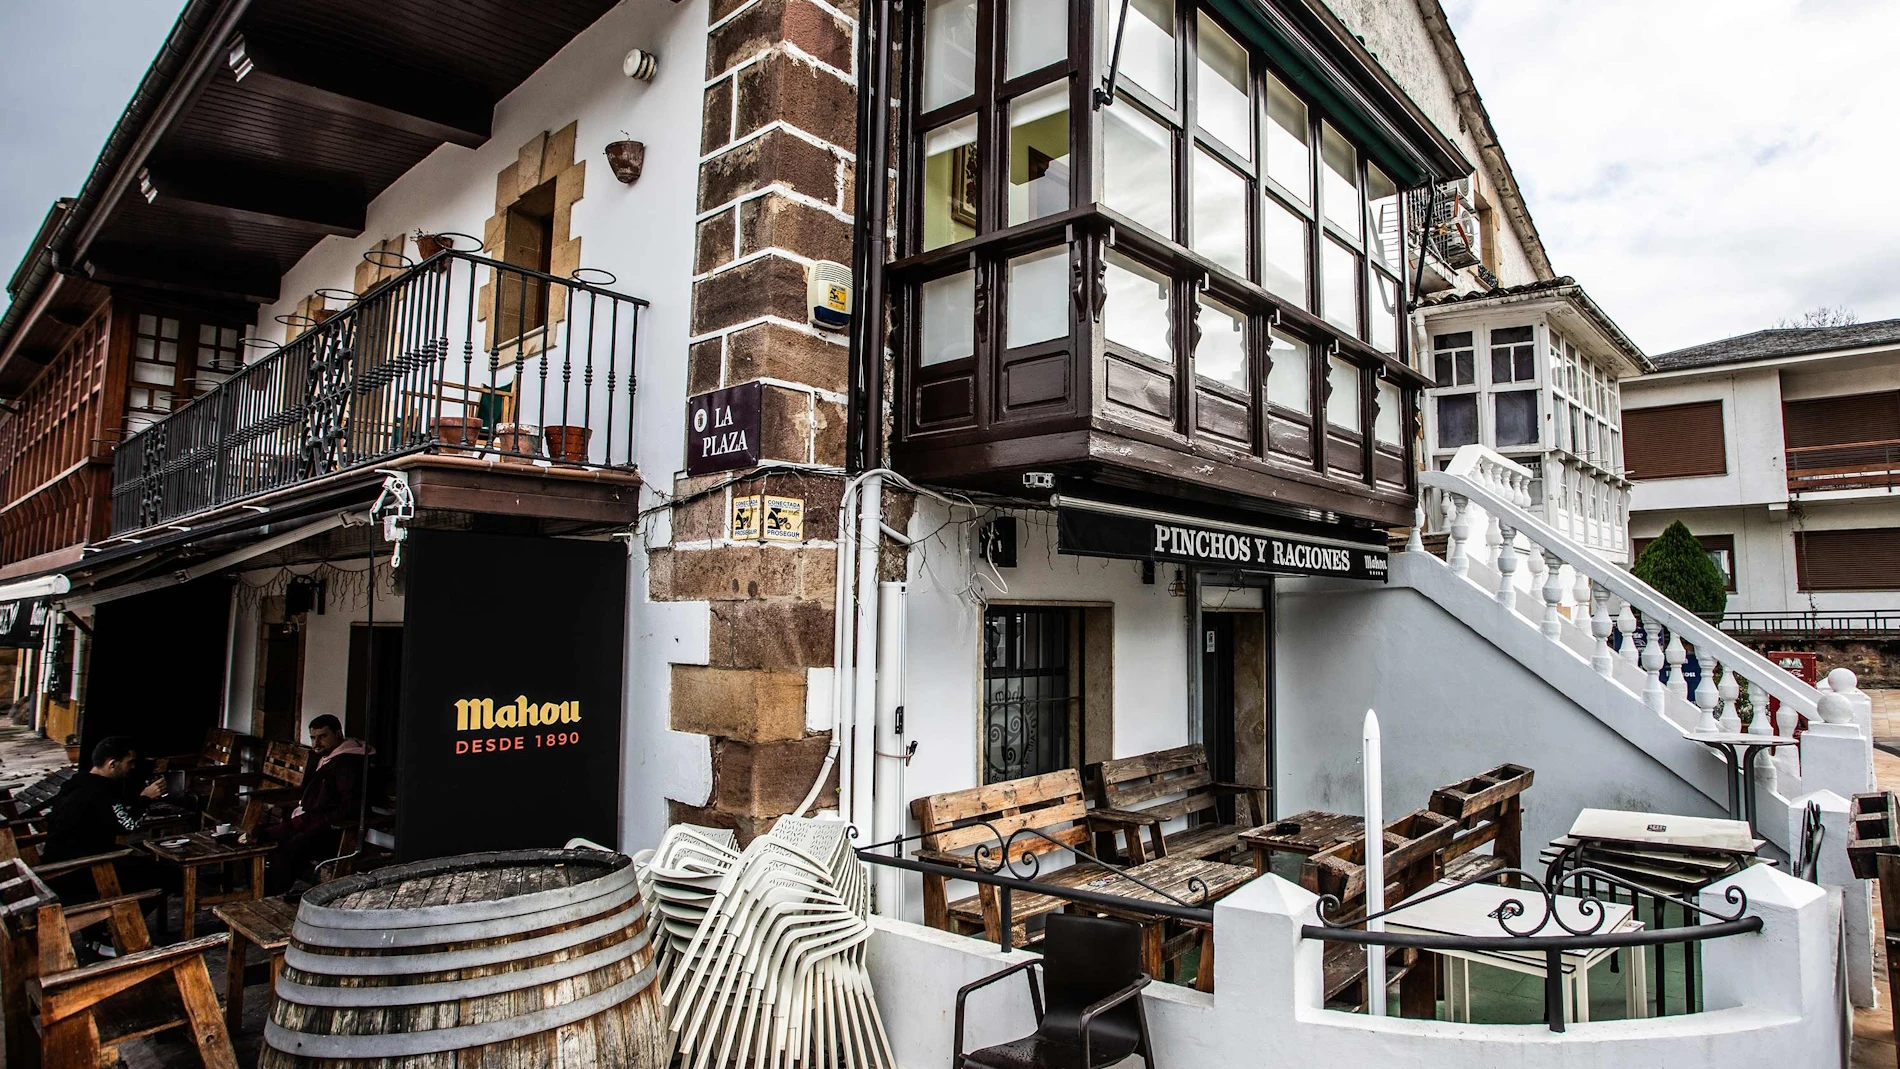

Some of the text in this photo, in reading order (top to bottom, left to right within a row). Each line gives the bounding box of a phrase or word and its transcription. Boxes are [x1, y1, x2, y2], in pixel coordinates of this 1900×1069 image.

[714, 405, 733, 428] LA
[702, 430, 748, 457] PLAZA
[735, 499, 758, 507] CONECADA
[767, 499, 801, 508] CONECTADA
[1154, 524, 1351, 572] PINCHOS Y RACIONES
[454, 694, 582, 731] Mahou
[455, 731, 580, 755] DESDE 1890
